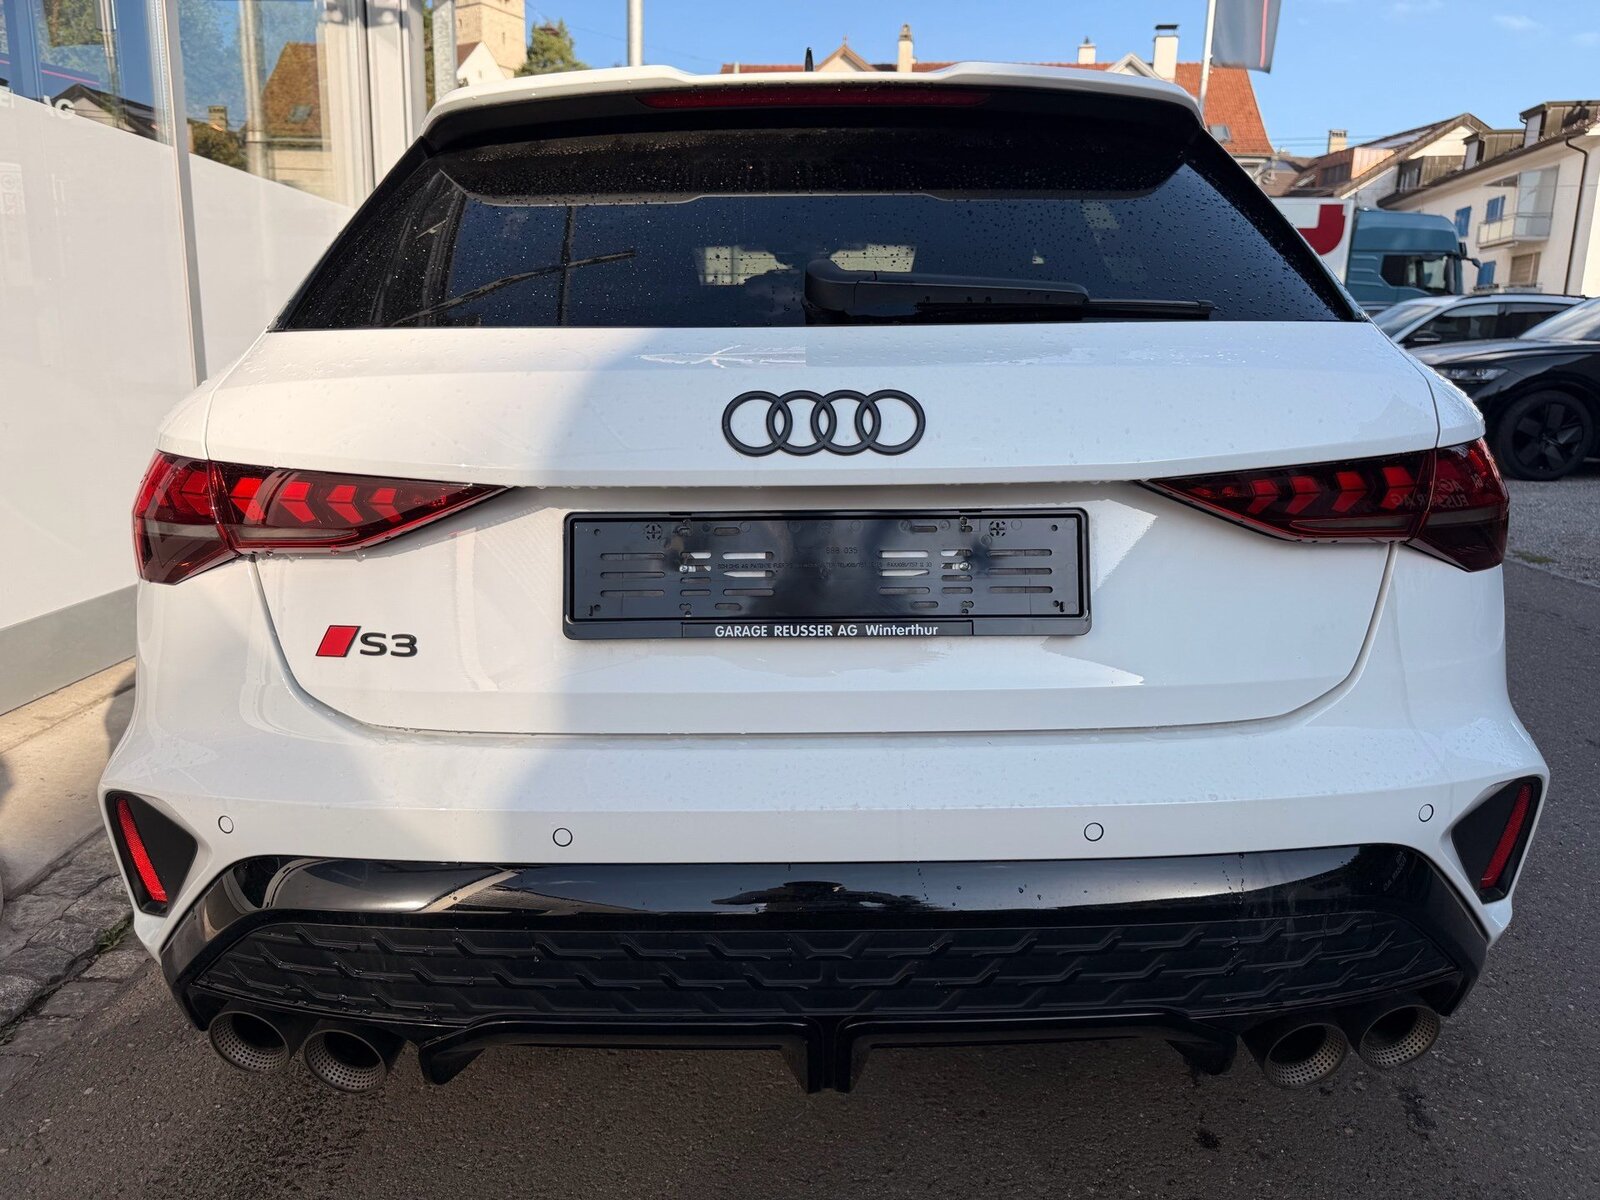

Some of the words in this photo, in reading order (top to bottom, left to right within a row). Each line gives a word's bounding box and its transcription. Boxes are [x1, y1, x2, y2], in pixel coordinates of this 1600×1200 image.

[714, 625, 768, 638] GARAGE
[774, 624, 834, 637] REUSSER
[837, 624, 858, 637] AG
[865, 623, 939, 637] Winterthur
[359, 632, 418, 657] S3
